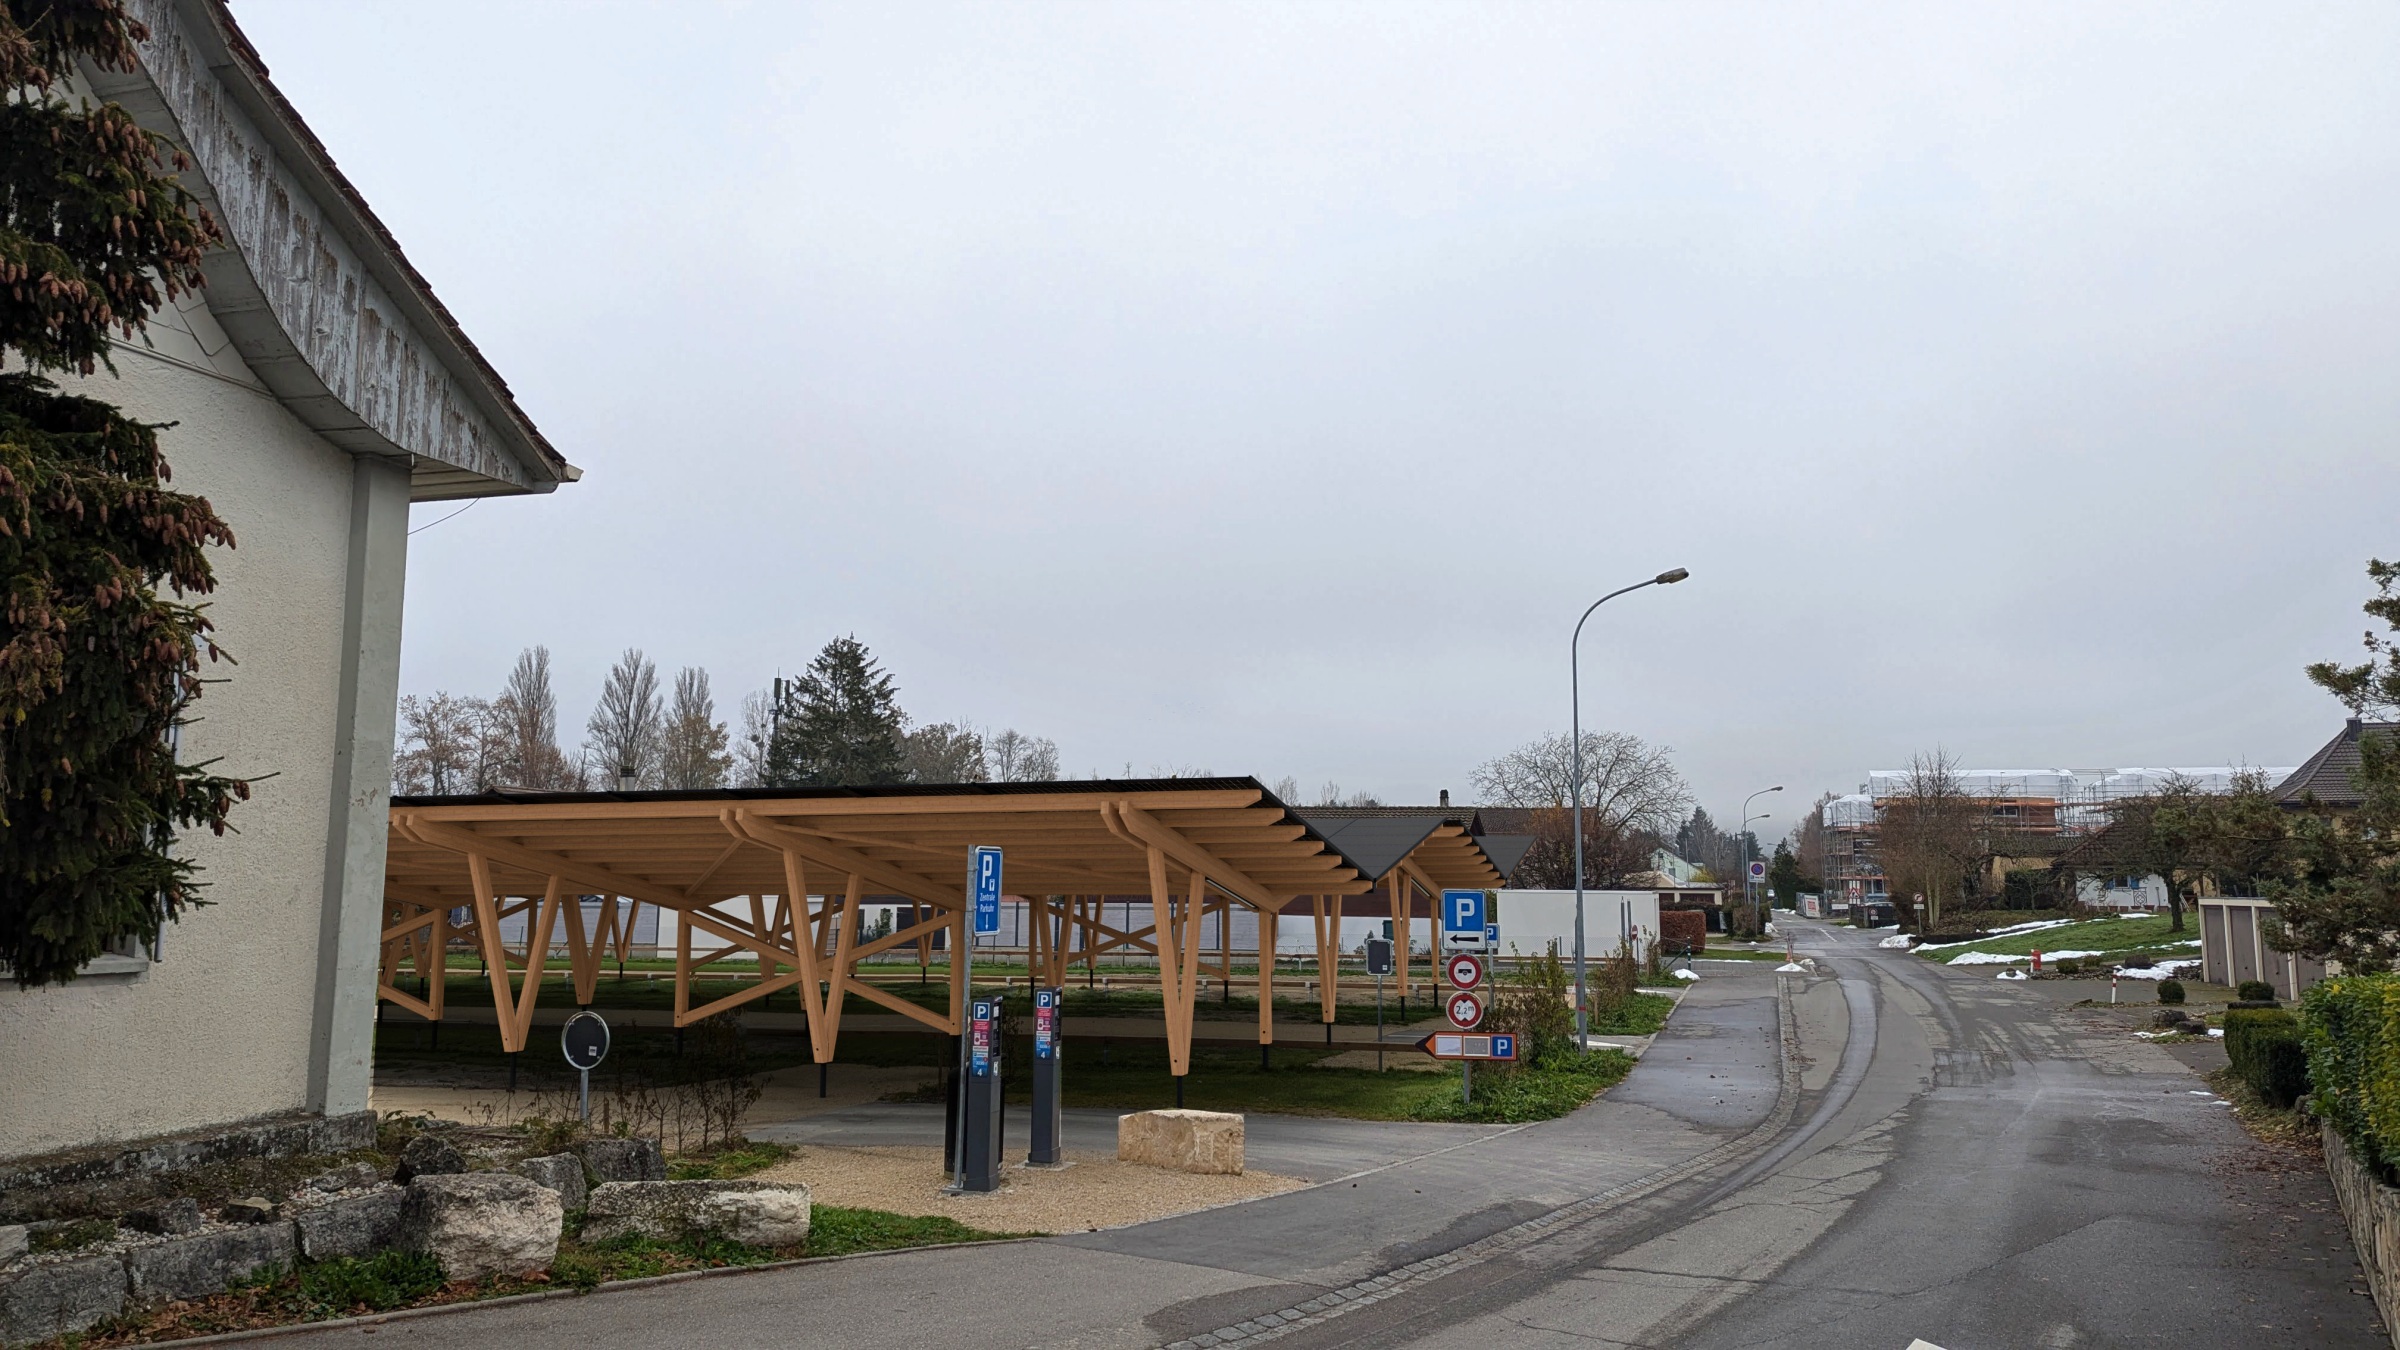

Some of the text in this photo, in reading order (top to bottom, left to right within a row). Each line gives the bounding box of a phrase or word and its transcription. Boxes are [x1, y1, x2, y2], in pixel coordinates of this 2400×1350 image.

[982, 855, 992, 888] P
[980, 893, 995, 902] Zentrale
[1456, 899, 1475, 927] P
[1487, 928, 1493, 939] P
[1040, 994, 1048, 1006] P
[977, 1006, 986, 1018] P
[1497, 1039, 1508, 1055] P
